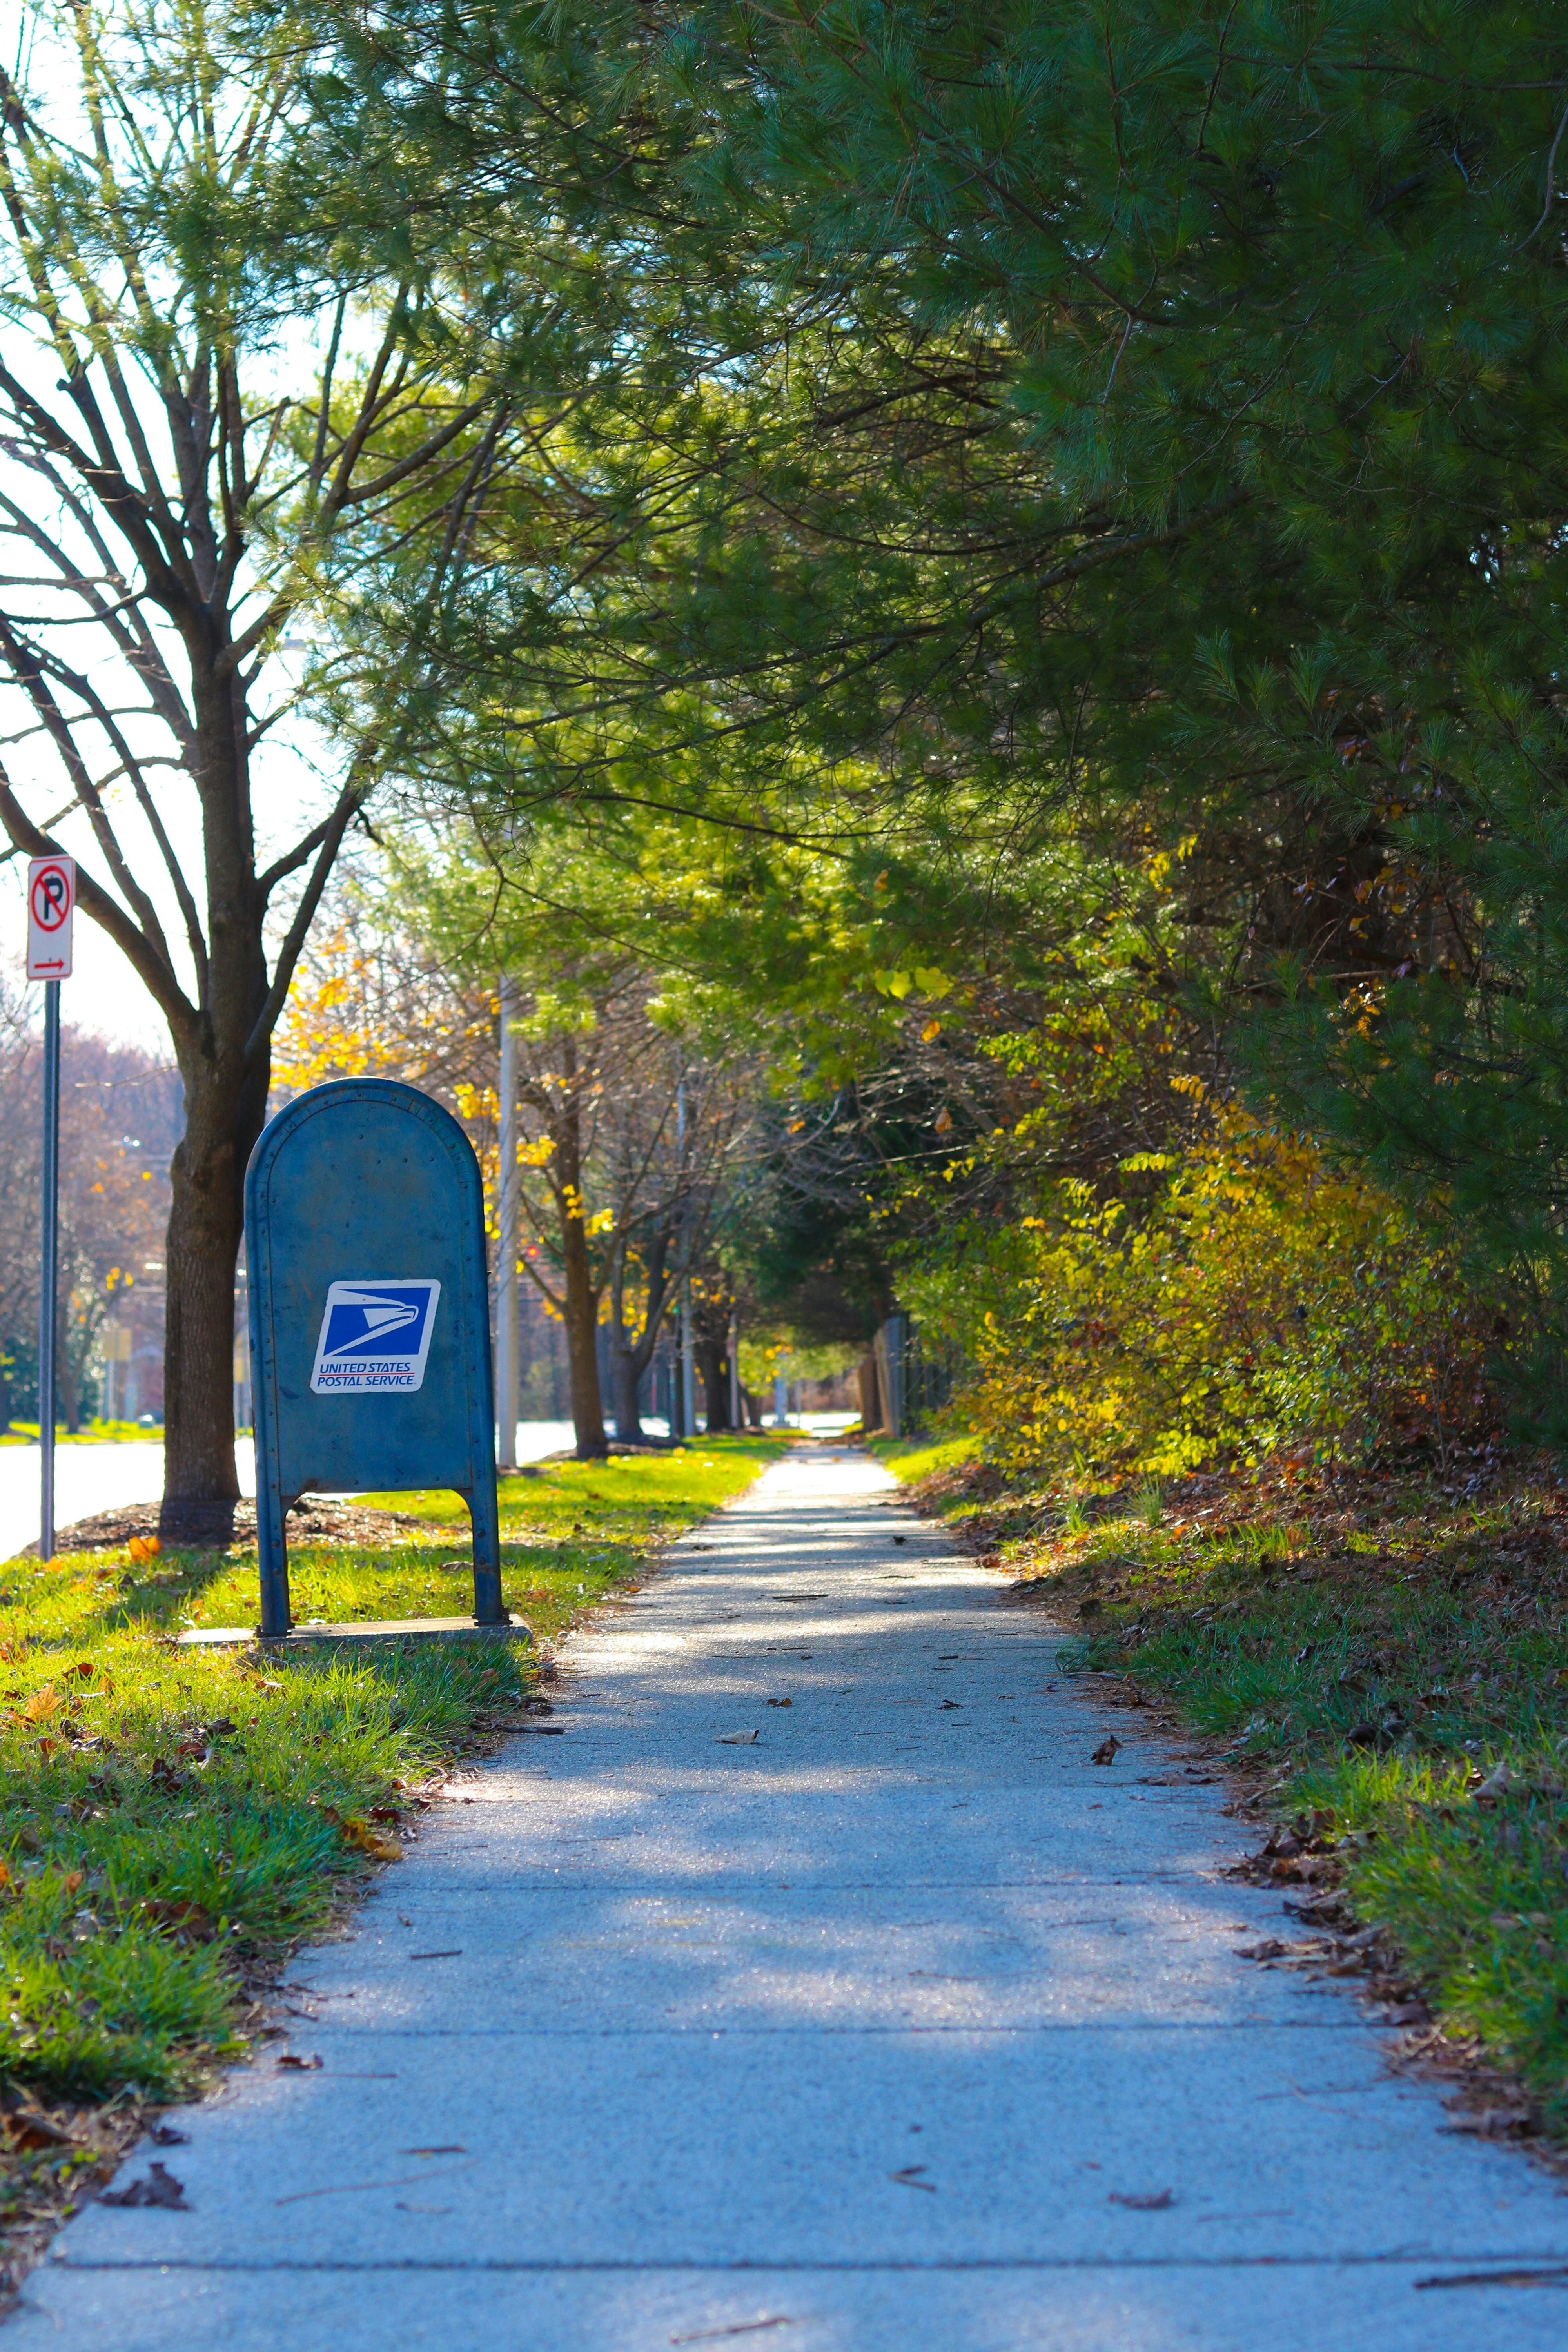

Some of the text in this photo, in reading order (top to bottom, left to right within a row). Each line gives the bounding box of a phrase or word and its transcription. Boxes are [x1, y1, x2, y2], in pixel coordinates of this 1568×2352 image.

[44, 878, 63, 920] P
[320, 1362, 410, 1373] UNITED STATES
[318, 1375, 414, 1387] POSTAL SERVICE
